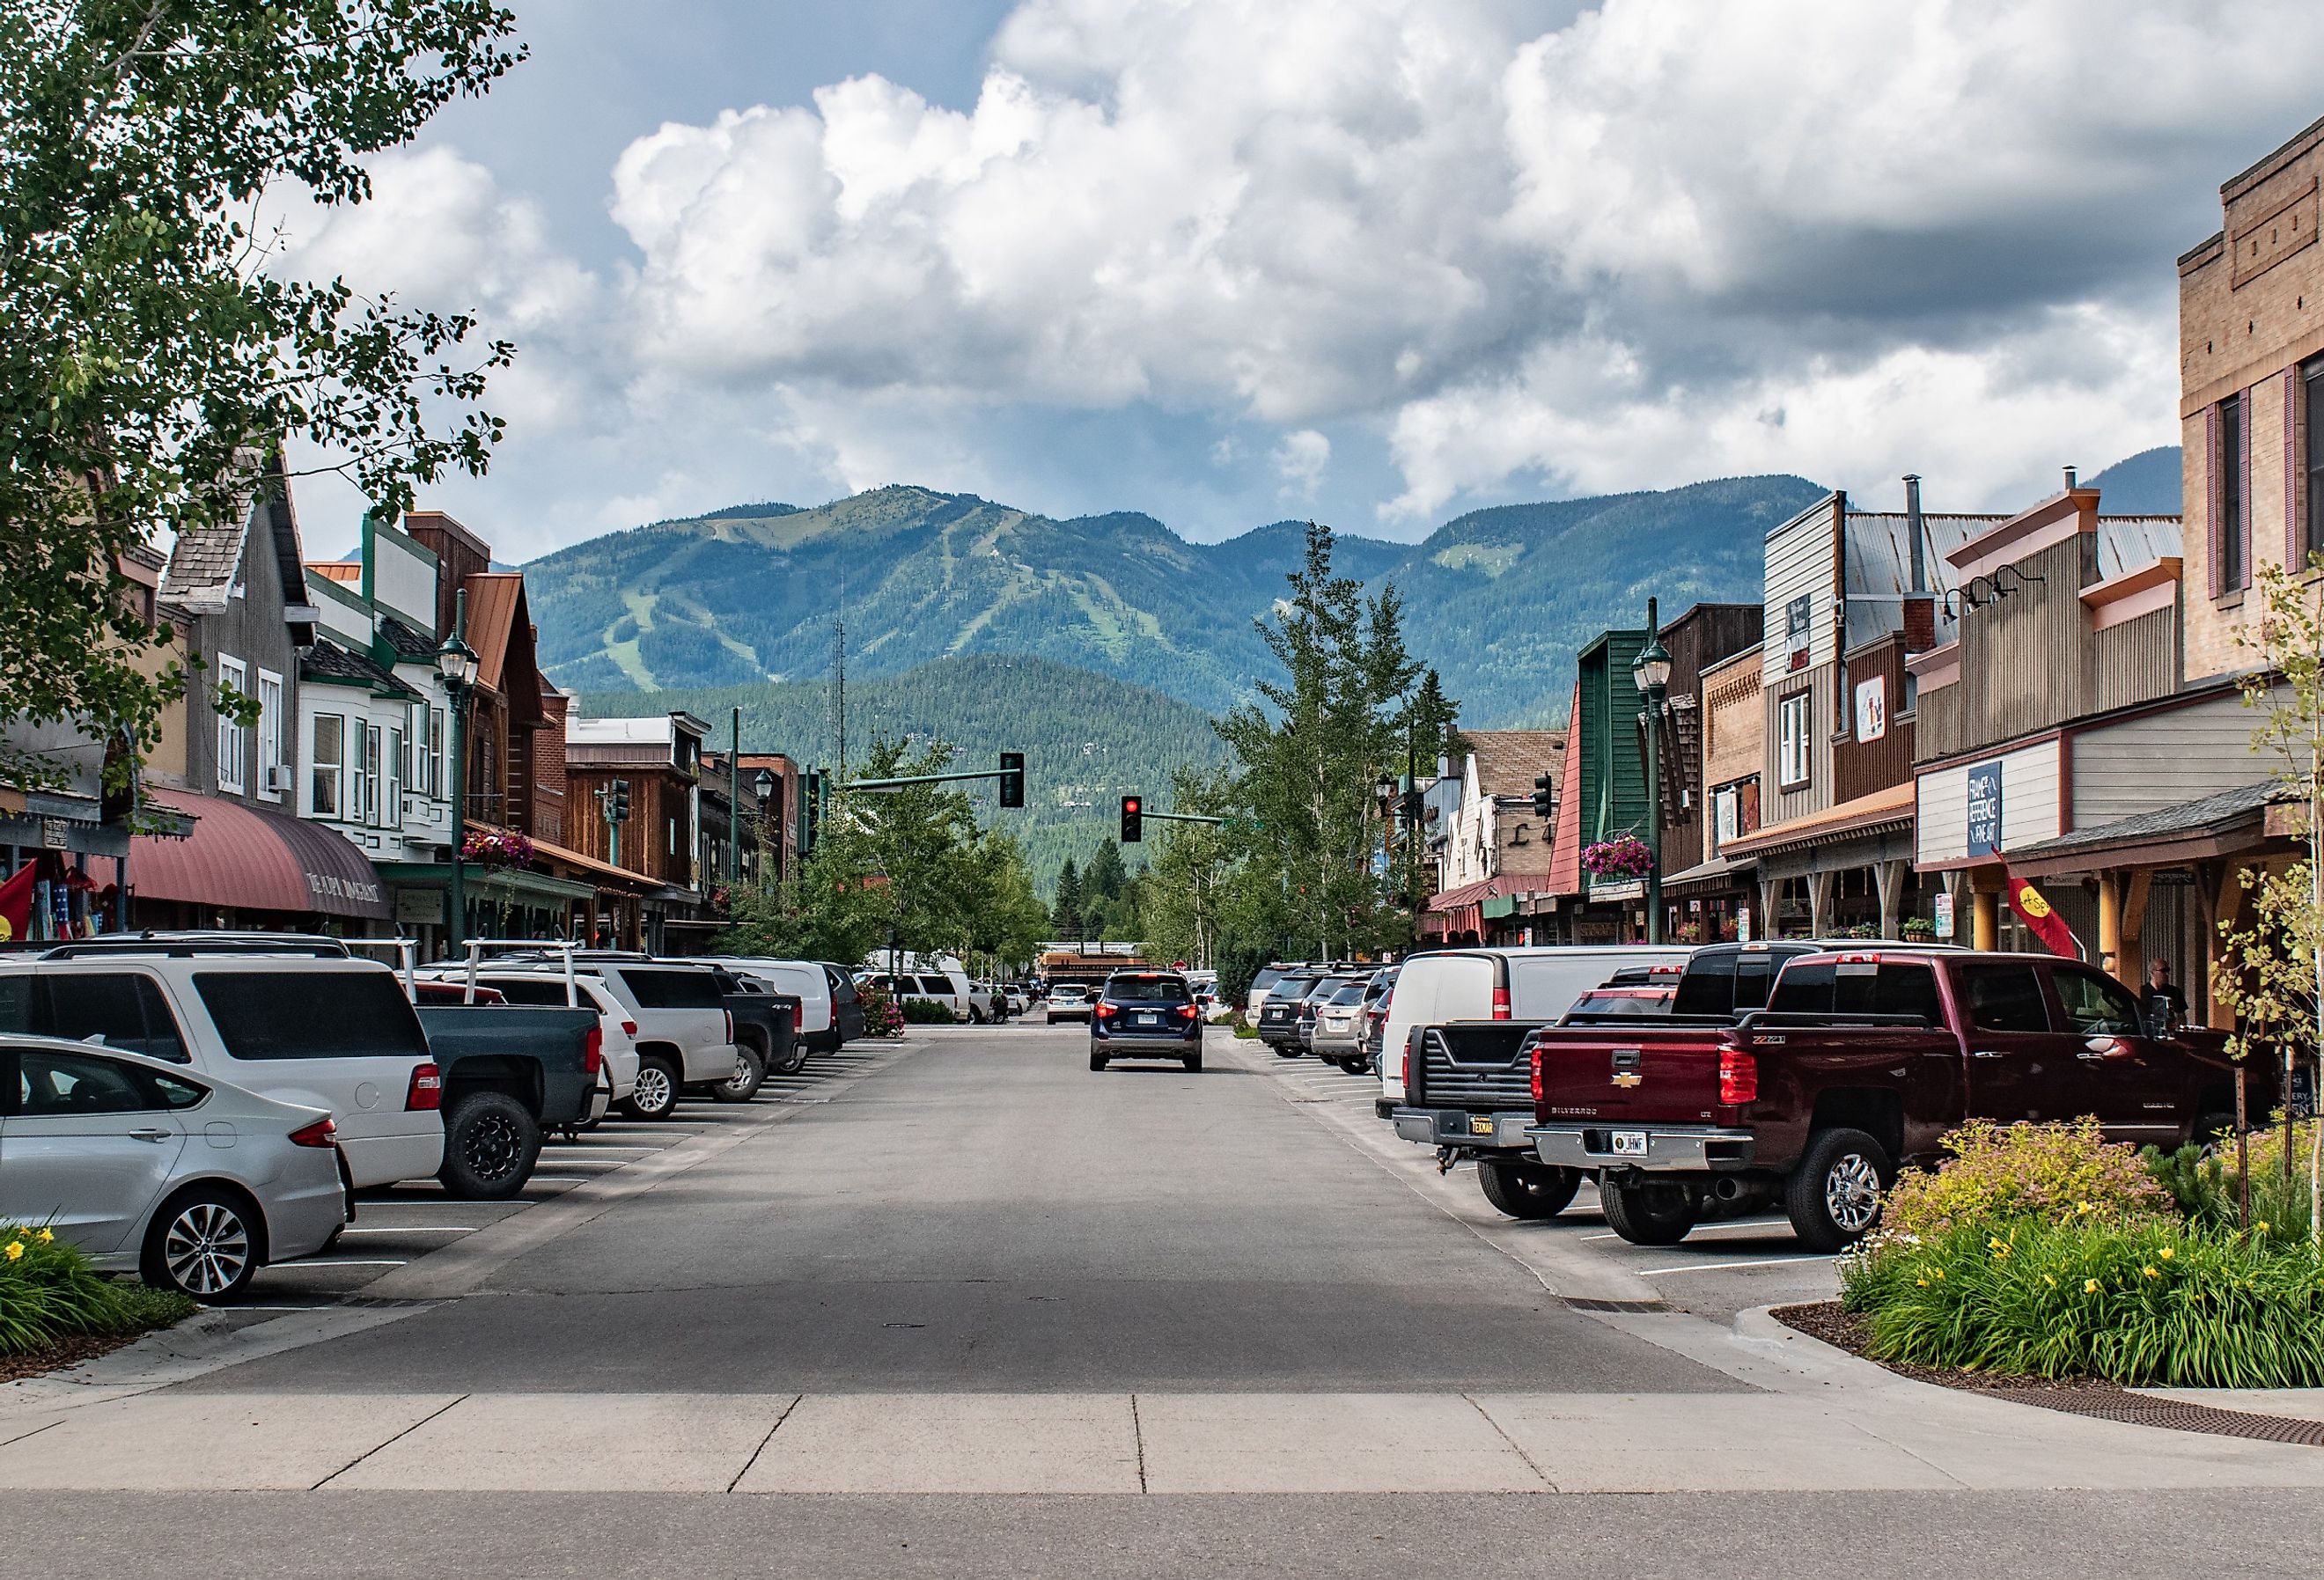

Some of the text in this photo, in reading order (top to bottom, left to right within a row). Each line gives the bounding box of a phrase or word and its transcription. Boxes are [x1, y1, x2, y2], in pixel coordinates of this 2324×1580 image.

[1969, 775, 1985, 801] FRAME
[1969, 797, 1997, 823] REFERENCE
[1551, 1106, 1598, 1115] SILVERADO
